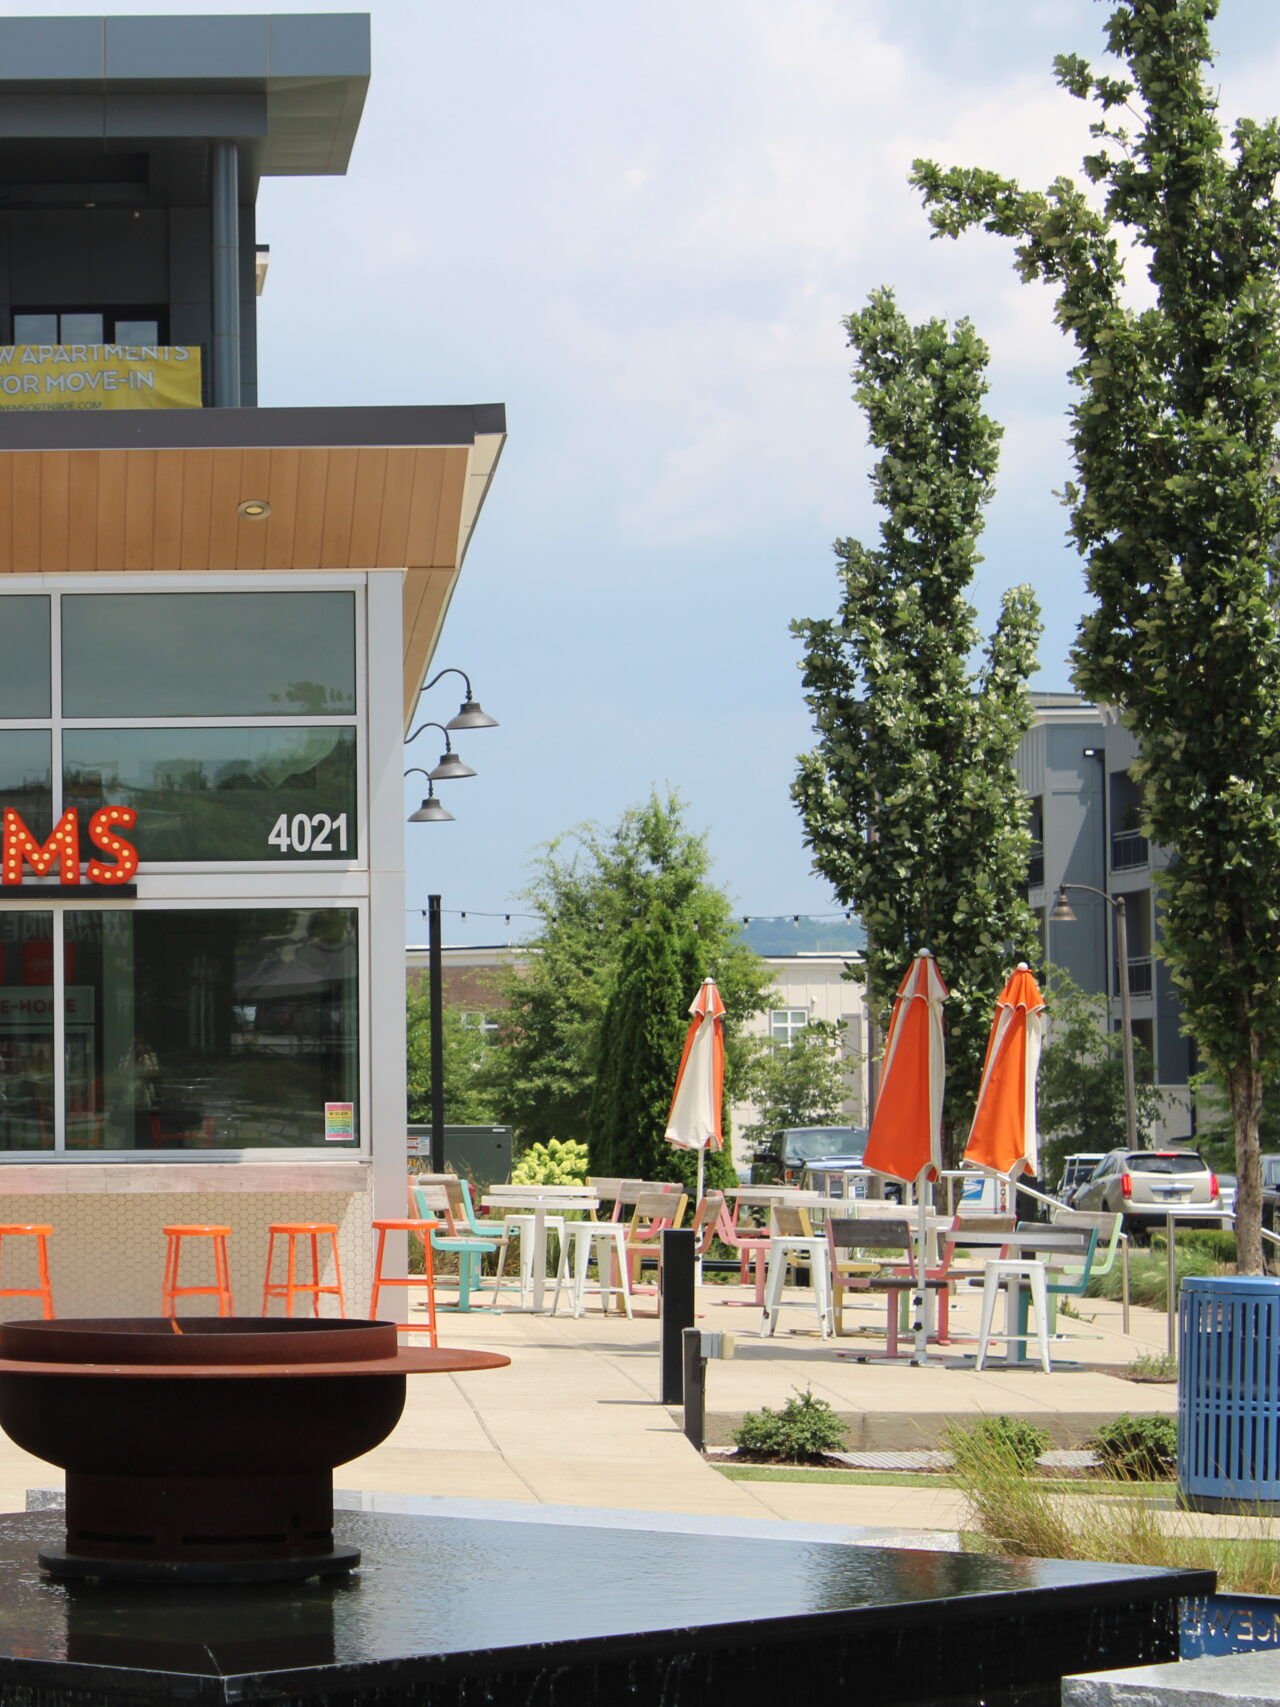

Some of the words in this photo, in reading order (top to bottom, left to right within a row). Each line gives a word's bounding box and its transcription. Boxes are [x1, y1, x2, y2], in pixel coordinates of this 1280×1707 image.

[20, 344, 190, 364] APARTMENTS
[45, 370, 155, 393] MOVE-IN
[268, 813, 347, 853] 4021
